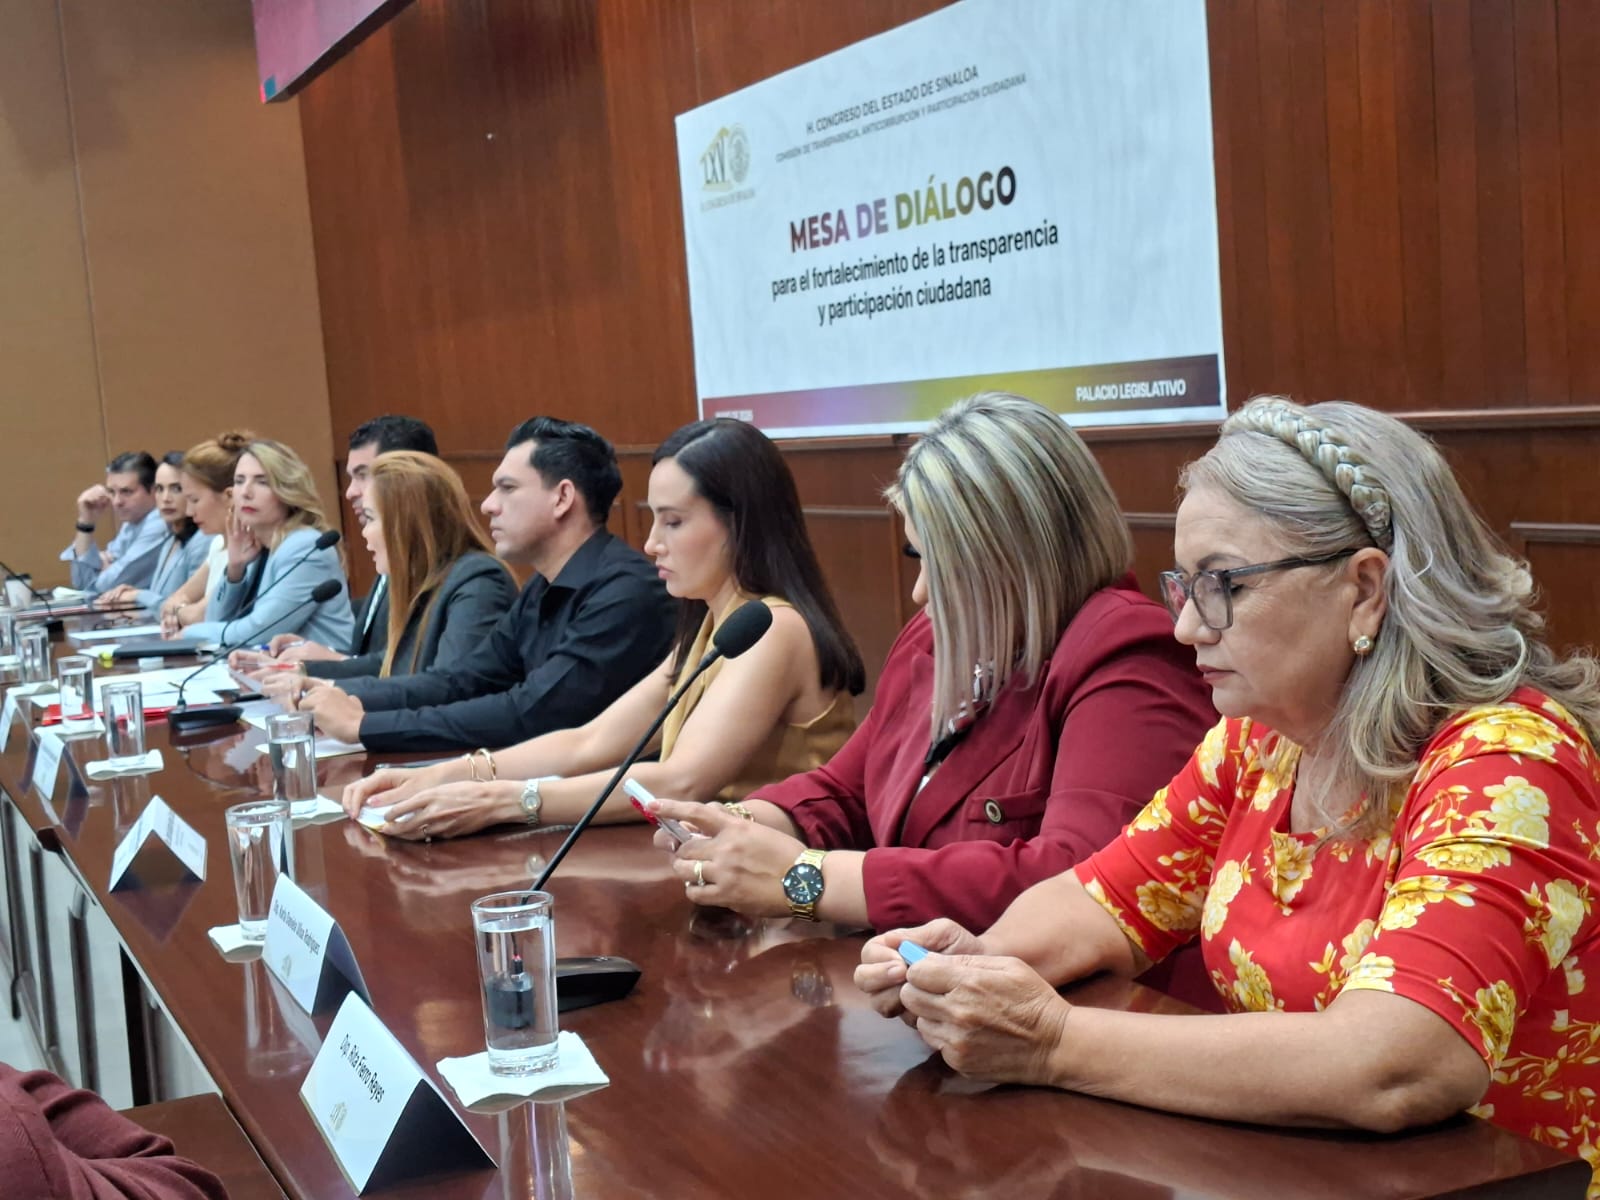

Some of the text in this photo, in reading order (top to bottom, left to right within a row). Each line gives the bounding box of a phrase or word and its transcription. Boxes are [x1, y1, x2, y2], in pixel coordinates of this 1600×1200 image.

[816, 106, 861, 132] CONGRESO
[863, 99, 880, 117] DEL
[881, 85, 919, 110] ESTADO
[920, 80, 934, 98] DE
[935, 65, 979, 93] SINALOA
[790, 165, 1016, 254] MESA DE DIÁLOGO
[772, 218, 1058, 302] para el fortalecimiento de la transparencia
[817, 275, 991, 327] y participación ciudadana
[1076, 379, 1187, 402] PALACIO LEGISLATIVO
[340, 1033, 385, 1104] Dip. Rita Fierro Reyes
